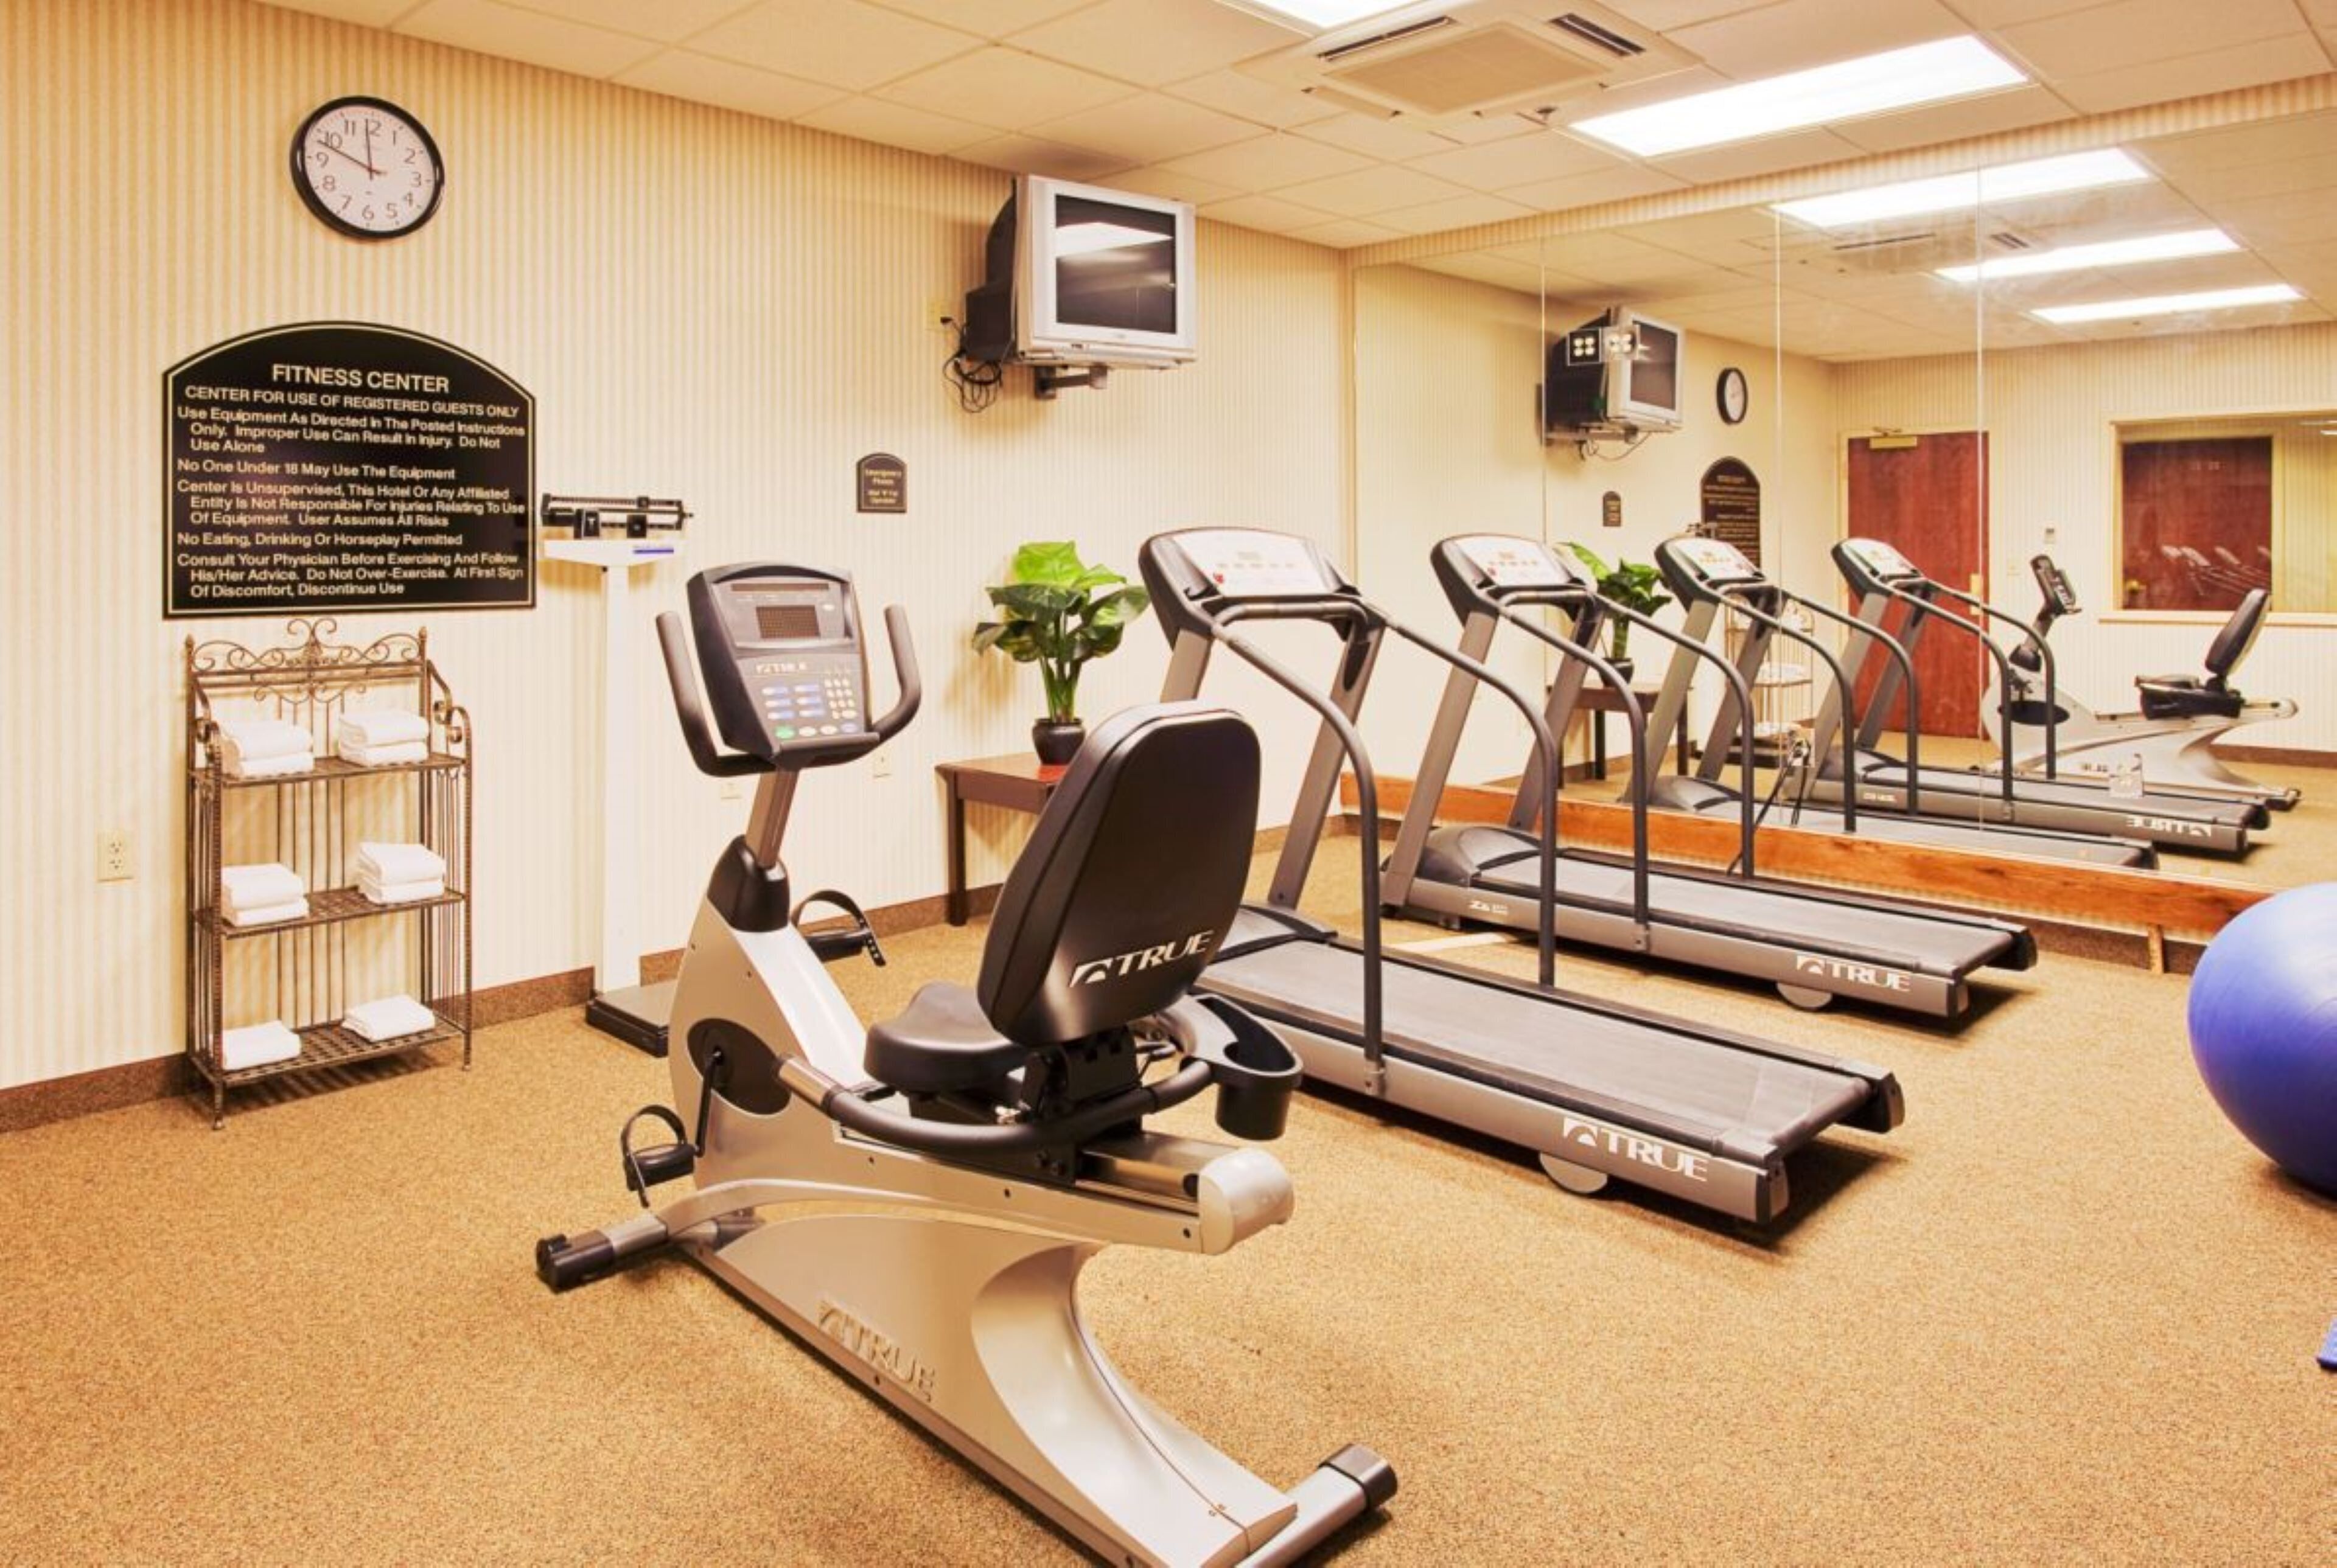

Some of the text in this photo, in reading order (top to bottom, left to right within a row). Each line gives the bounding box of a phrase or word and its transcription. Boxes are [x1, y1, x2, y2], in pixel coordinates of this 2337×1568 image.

[344, 119, 356, 137] 11
[316, 152, 329, 168] 9
[403, 148, 416, 164] 2
[323, 175, 336, 192] 8
[410, 172, 422, 187] 3
[341, 195, 352, 209] 7
[403, 192, 414, 207] 4
[362, 204, 375, 220] 6
[386, 203, 398, 219] 5
[273, 363, 449, 393] FITNESS CENTER
[185, 385, 519, 418] CENTER FOR USE OF REGISTERED GUESTS ONLY
[177, 406, 526, 437] Use Equipment As Directed In The Posted Instructions
[190, 422, 501, 450] Only. Improper Use Can Result In Injury. Do Not
[190, 438, 265, 453] Use Alone
[177, 459, 455, 481] No One Under 18 May Use The Equipment
[177, 479, 510, 500] Center Is Unsupervised, This Hotel Or Any Affiliated
[190, 496, 525, 515] Entity Is Not Responsible For Injuries Relating To Use
[190, 512, 210, 525] Of
[299, 513, 330, 525] User
[333, 514, 394, 526] Assumes
[397, 514, 414, 526] All
[416, 515, 449, 527] Risks
[177, 532, 463, 548] No Eating, Drinking Or Horseplay Permitted
[177, 552, 518, 568] Consult Your Physician Before Exercising And Follow
[190, 566, 523, 582] His/Her Advice. Do Not Over-Exercise. At First Sign
[190, 582, 405, 598] Of Discomfort, Discontinue Use
[1116, 930, 1214, 976] TRUE
[1826, 960, 1911, 992] TRUE
[1600, 1127, 1708, 1182] TRUE
[844, 1313, 935, 1403] TRUE
